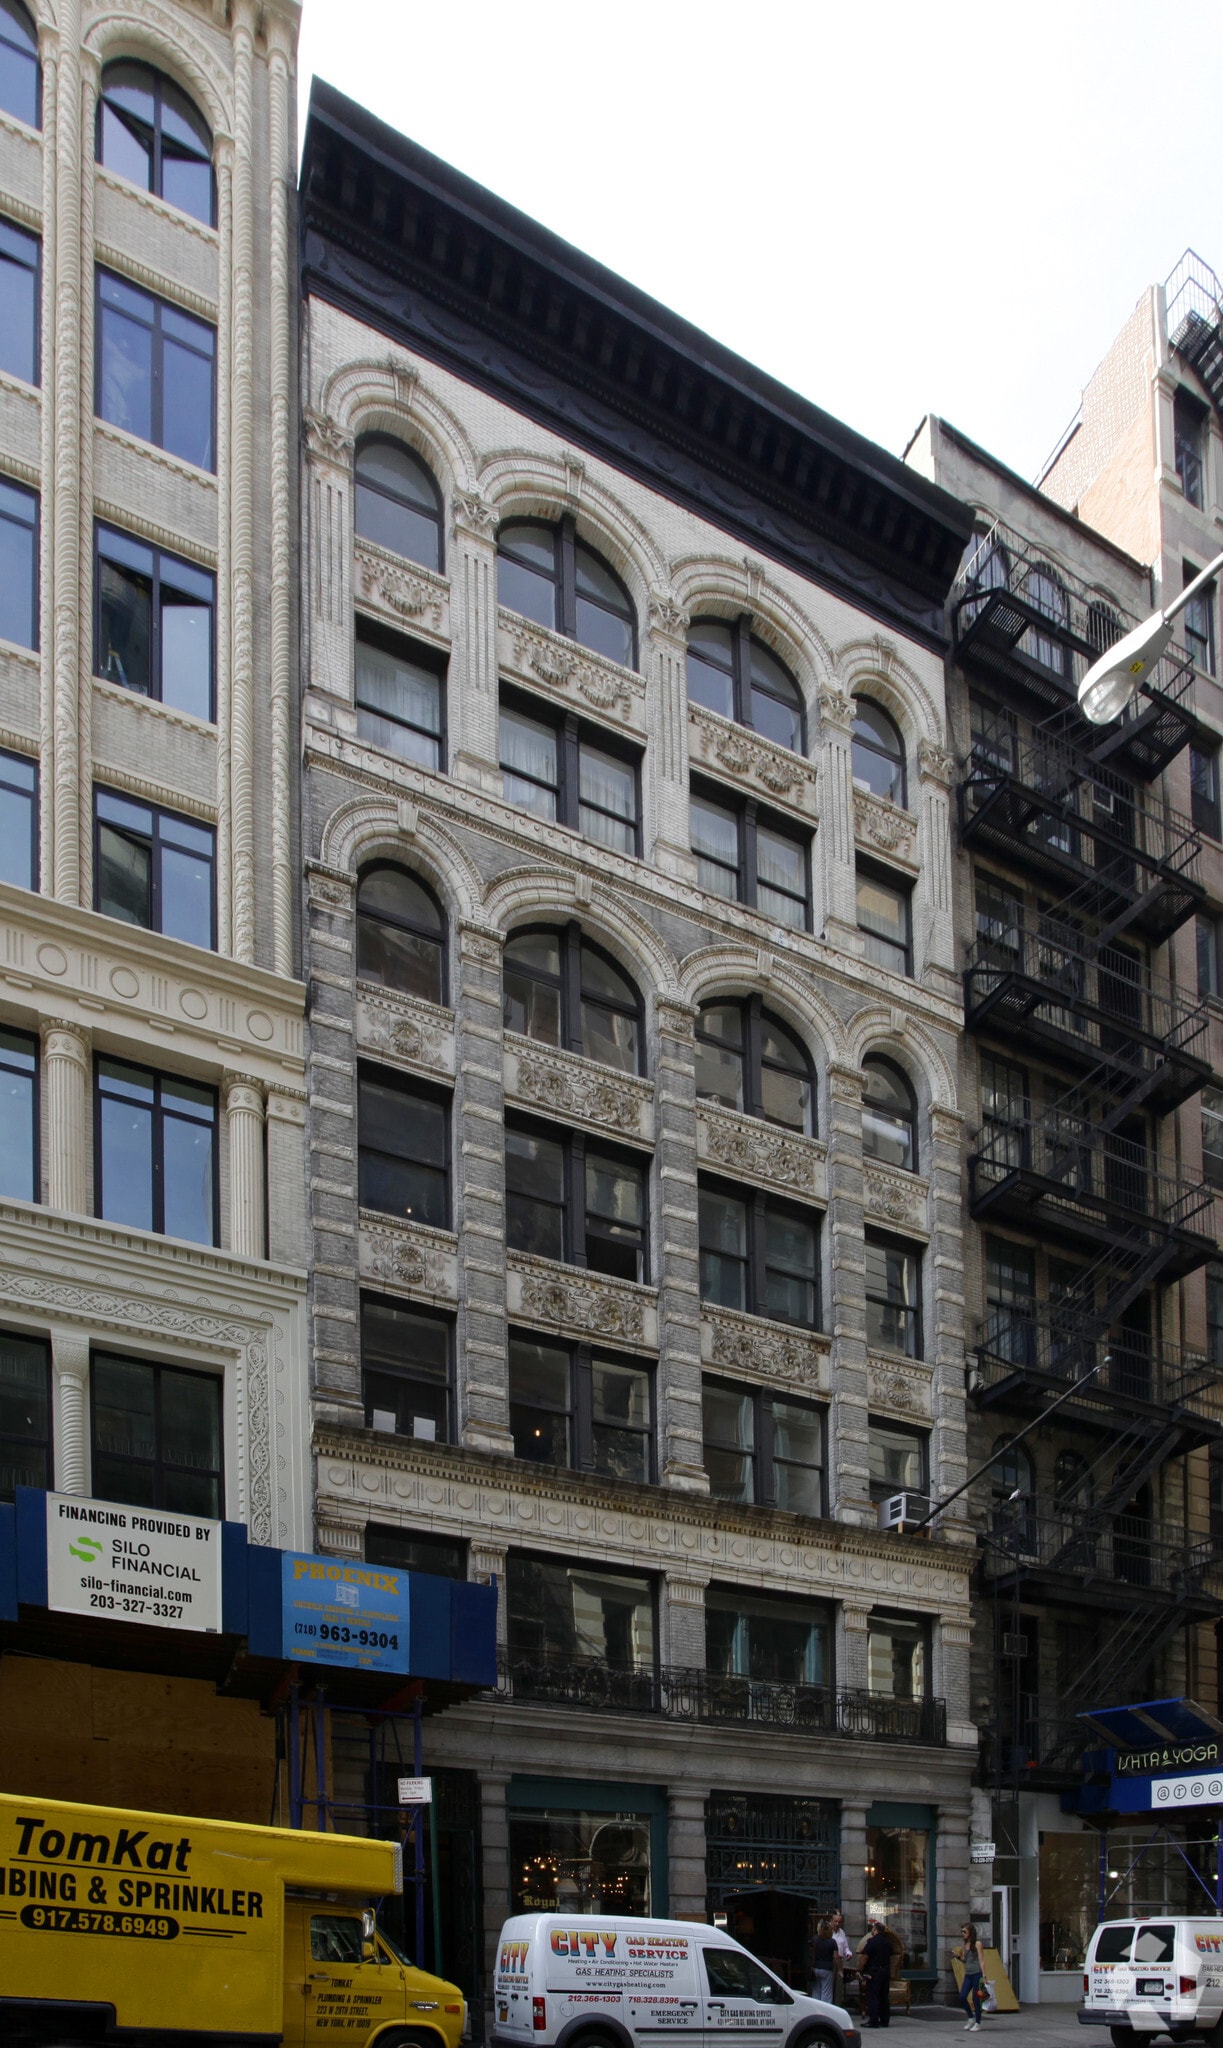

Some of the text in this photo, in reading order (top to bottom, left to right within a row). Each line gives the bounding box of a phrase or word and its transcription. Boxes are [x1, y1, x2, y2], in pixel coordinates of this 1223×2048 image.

[59, 1504, 210, 1541] FINANCING PROVIDED BY
[112, 1539, 150, 1557] SILO
[112, 1556, 201, 1582] FINANCIAL
[293, 1560, 400, 1596] PHOENIX
[80, 1576, 192, 1603] silo-financial.com
[90, 1593, 183, 1619] 203-327-3327
[294, 1623, 317, 1637] (718)
[320, 1624, 399, 1650] 963-9304
[1118, 1744, 1218, 1771] ISHTA YOGA
[15, 1816, 192, 1872] TomKat
[88, 1876, 107, 1904] &
[118, 1879, 263, 1918] SPRINKLER
[523, 1895, 561, 1909] Royal
[32, 1908, 169, 1936] 917.578.6949
[550, 1930, 617, 1958] CITY
[625, 1936, 689, 1948] GAS HEATING
[1194, 1933, 1223, 1953] CIT
[501, 1942, 529, 1973] CITY
[568, 1958, 588, 1966] Heating
[600, 1959, 629, 1967] Conditioning
[628, 1948, 689, 1960] SERVICE
[576, 1968, 674, 1978] GAS HEATING SPECIALISTS
[1093, 1964, 1116, 1974] CITY
[331, 1979, 353, 1988] TOMKAT
[586, 1981, 666, 1989] www.citygasheating.com
[1206, 1978, 1221, 1988] 212
[317, 1993, 346, 2003] PLUMBING
[353, 1995, 382, 2005] SPRINKLER
[568, 1995, 621, 2003] 212.366-1303
[316, 2018, 329, 2027] NEW
[347, 2020, 355, 2028] NY
